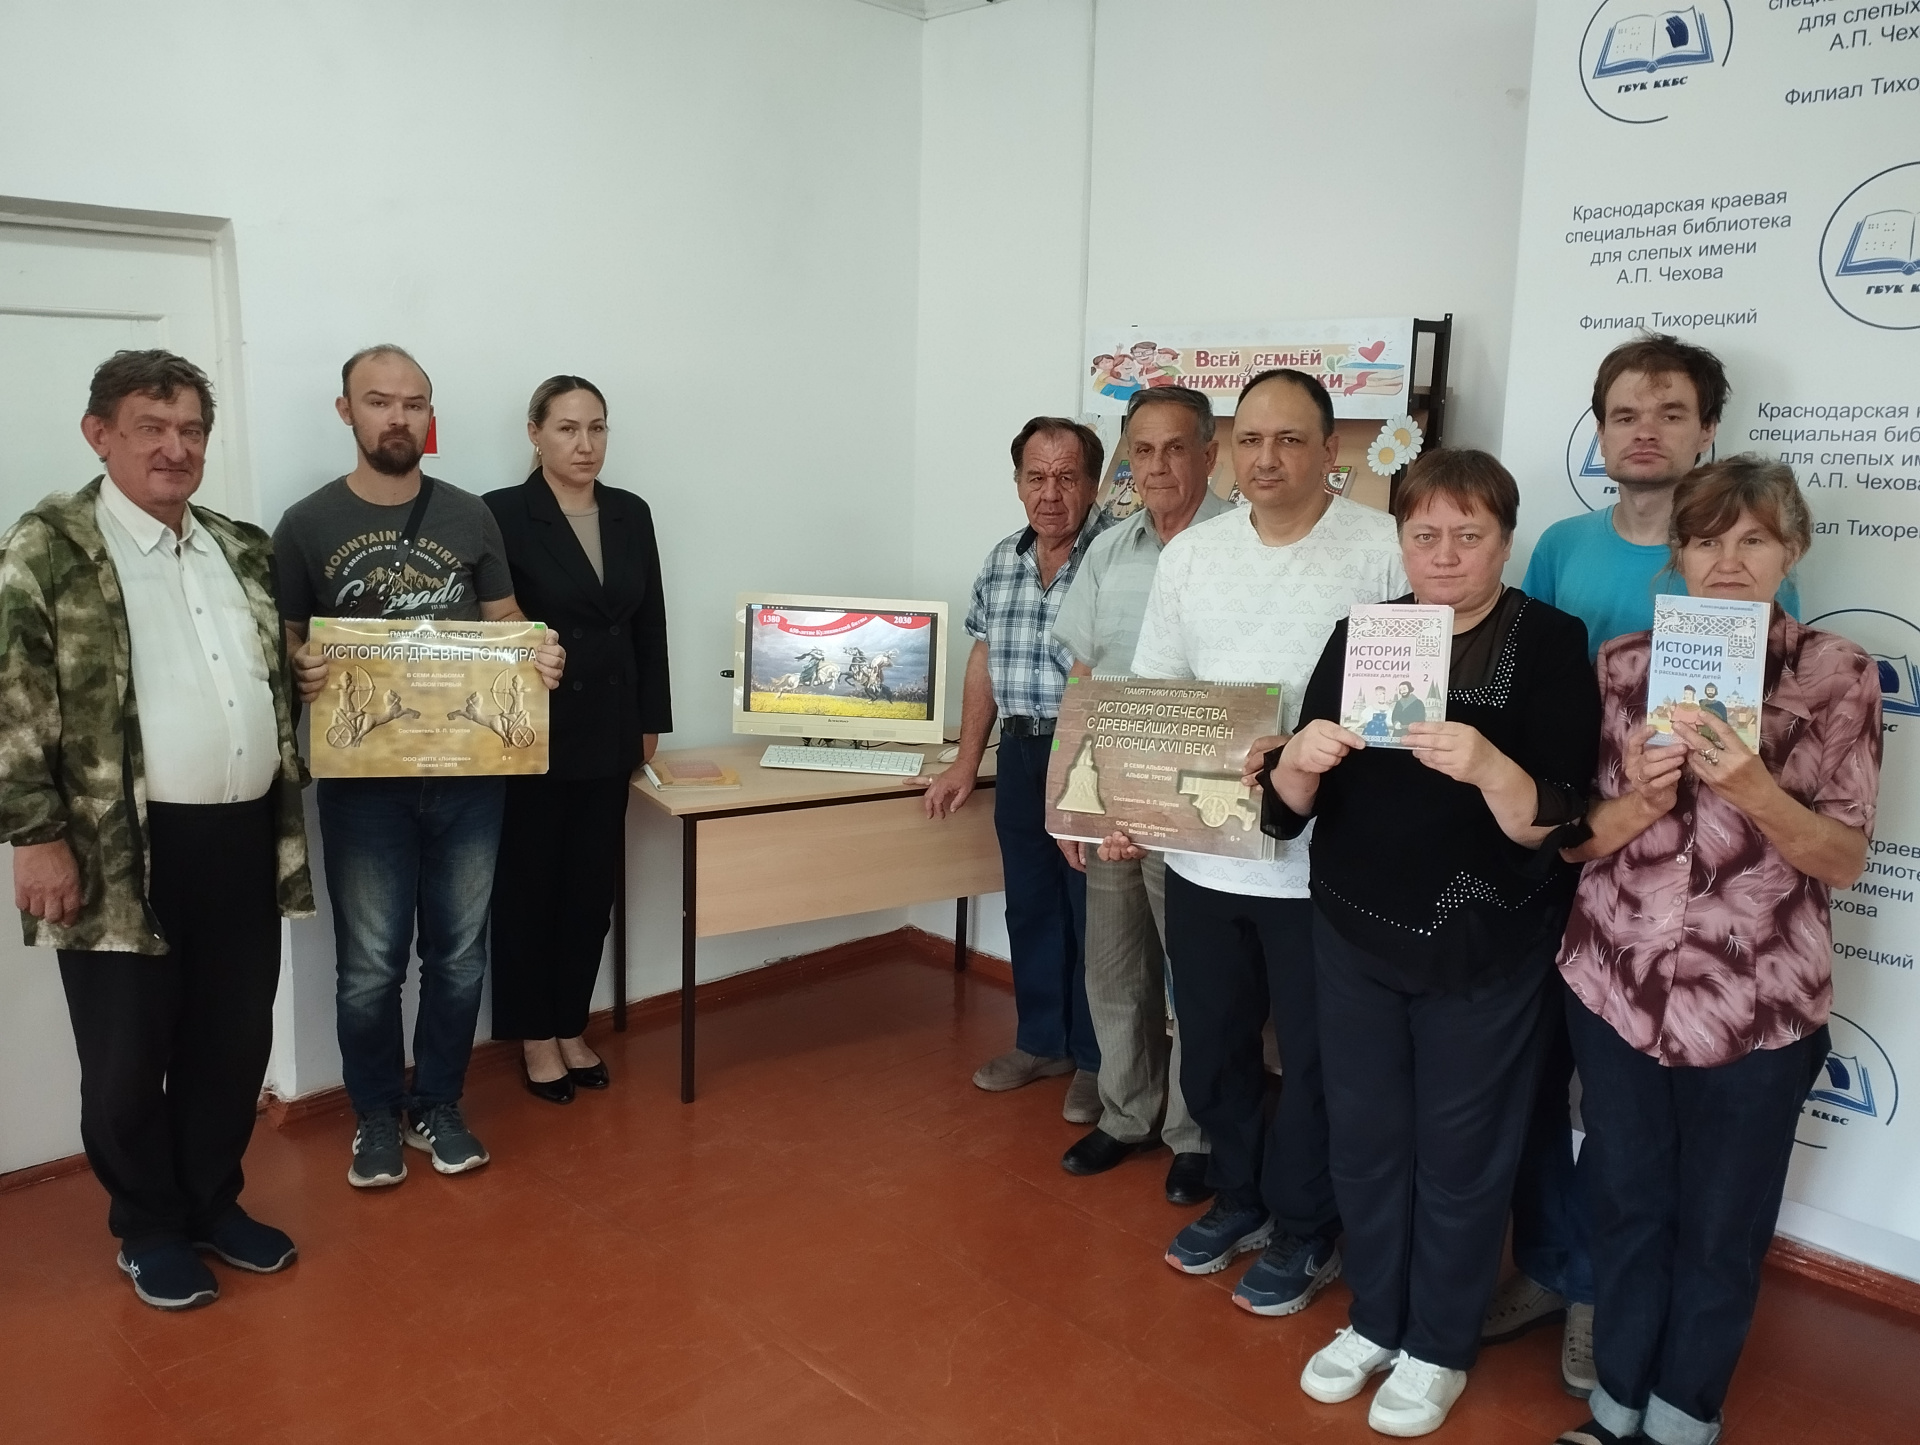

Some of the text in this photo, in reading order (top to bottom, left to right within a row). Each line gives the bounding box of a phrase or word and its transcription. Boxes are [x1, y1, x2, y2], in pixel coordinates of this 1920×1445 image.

[1798, 13, 1836, 34] для
[1829, 25, 1920, 51] А.П. Чех
[1617, 76, 1689, 93] ГБУК ККБС
[1785, 84, 1863, 105] Филиал
[1572, 191, 1788, 224] Краснодарская краевая
[1565, 214, 1792, 244] специальная библиотека
[1590, 241, 1757, 267] для слепых имени
[1616, 266, 1723, 285] А.П. Чехова
[1866, 284, 1904, 295] ГБУК
[1579, 308, 1758, 330] Филиал Тихорецкий
[1758, 402, 1909, 422] Краснодарская
[1749, 428, 1877, 444] специальная
[1779, 452, 1814, 464] для
[1820, 452, 1894, 466] слепых
[1807, 472, 1848, 489] А.П.
[1847, 519, 1920, 542] Тихоре
[324, 530, 462, 580] MOUNTAIN SPIRIT
[348, 550, 368, 567] BRAVE
[368, 545, 383, 554] AND
[415, 550, 442, 570] SURVIVE
[763, 615, 781, 623] 1380
[893, 616, 912, 624] 2030
[324, 645, 404, 660] ИСТОРИЯ
[407, 646, 491, 663] ДРЕВНЕГО
[1350, 645, 1411, 657] ИСТОРИЯ
[1655, 640, 1723, 657] ИСТОРИЯ
[1356, 660, 1410, 671] РОССИИ
[1663, 656, 1722, 673] РОССИИ
[1423, 674, 1429, 682] 2
[1659, 670, 1688, 678] рассказах
[1736, 676, 1742, 685] 1
[1124, 687, 1209, 699] ПАМЯТНИКИ КУЛЬТУРЫ
[1097, 701, 1228, 721] ИСТОРИЯ ОТЕЧЕСТВА
[1087, 717, 1234, 740] С ДРЕВНЕЙШИХ ВРЕМЁН
[1095, 735, 1217, 757] ДО КОНЦА XVII ВЕКА
[1852, 882, 1914, 903] имени
[1833, 943, 1913, 969] орецкий
[1811, 1109, 1850, 1126] ККБС
